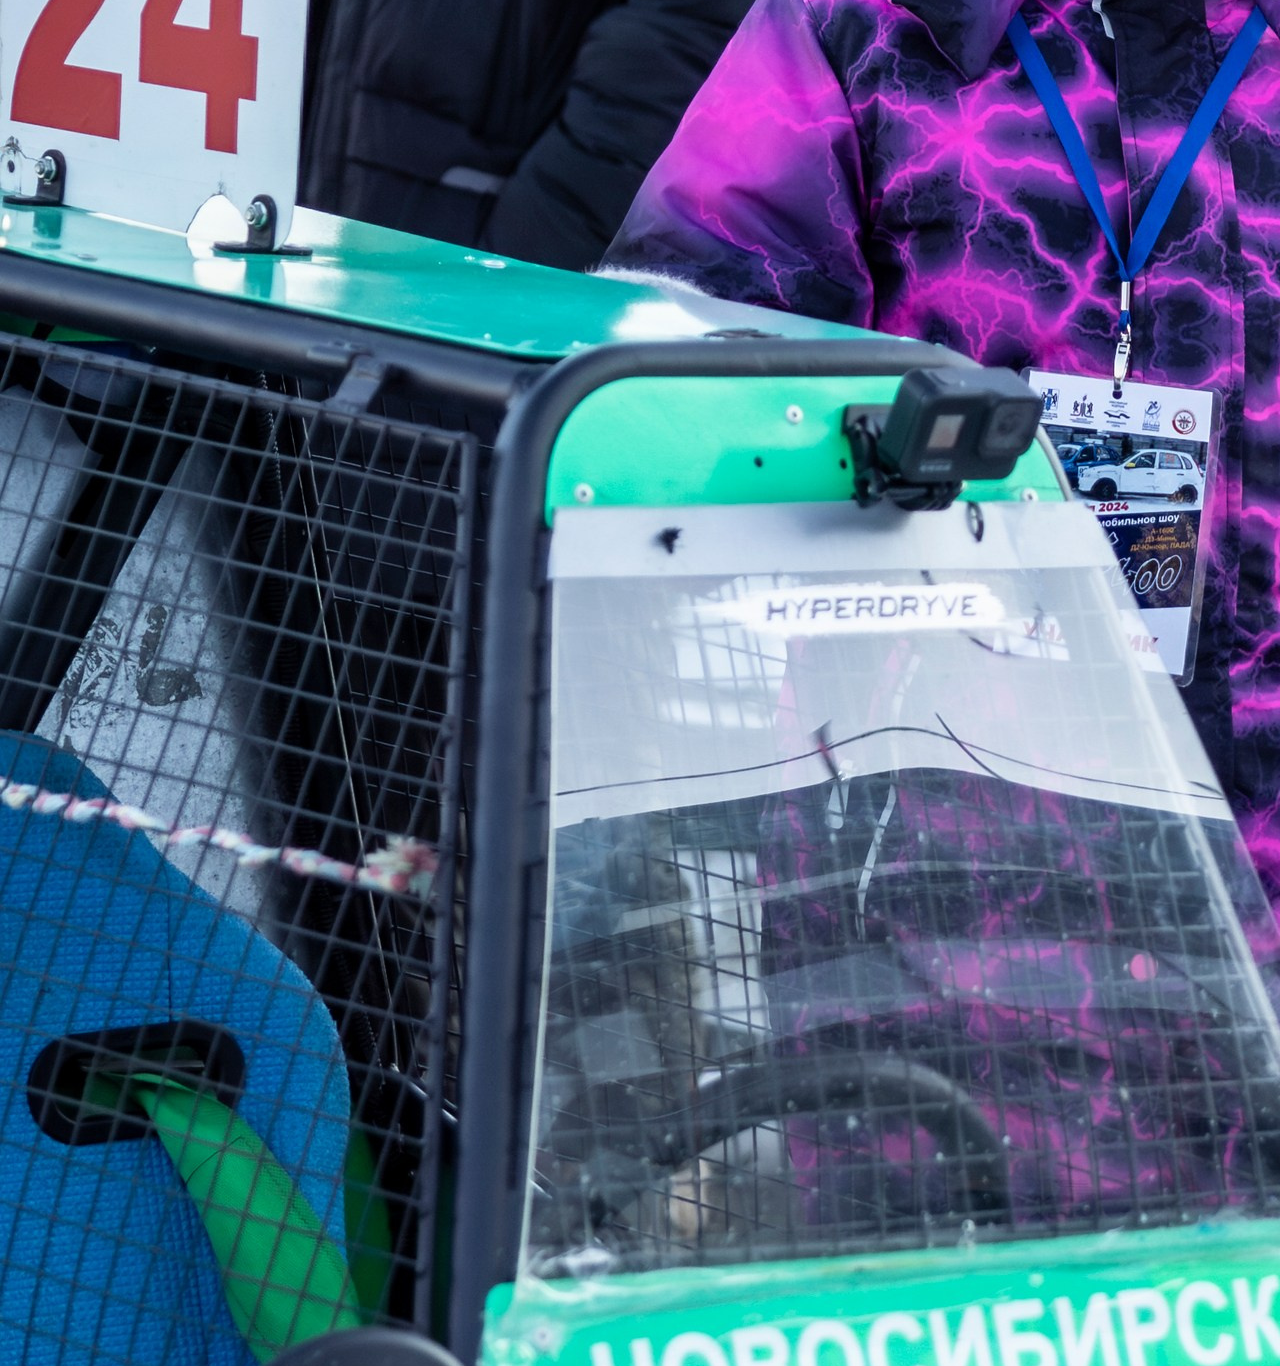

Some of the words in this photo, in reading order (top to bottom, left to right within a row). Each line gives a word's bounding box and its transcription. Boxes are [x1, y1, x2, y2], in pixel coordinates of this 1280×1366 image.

[1098, 502, 1129, 512] 2024
[1158, 514, 1180, 525] шоу
[766, 595, 977, 621] HYPERDRYVE
